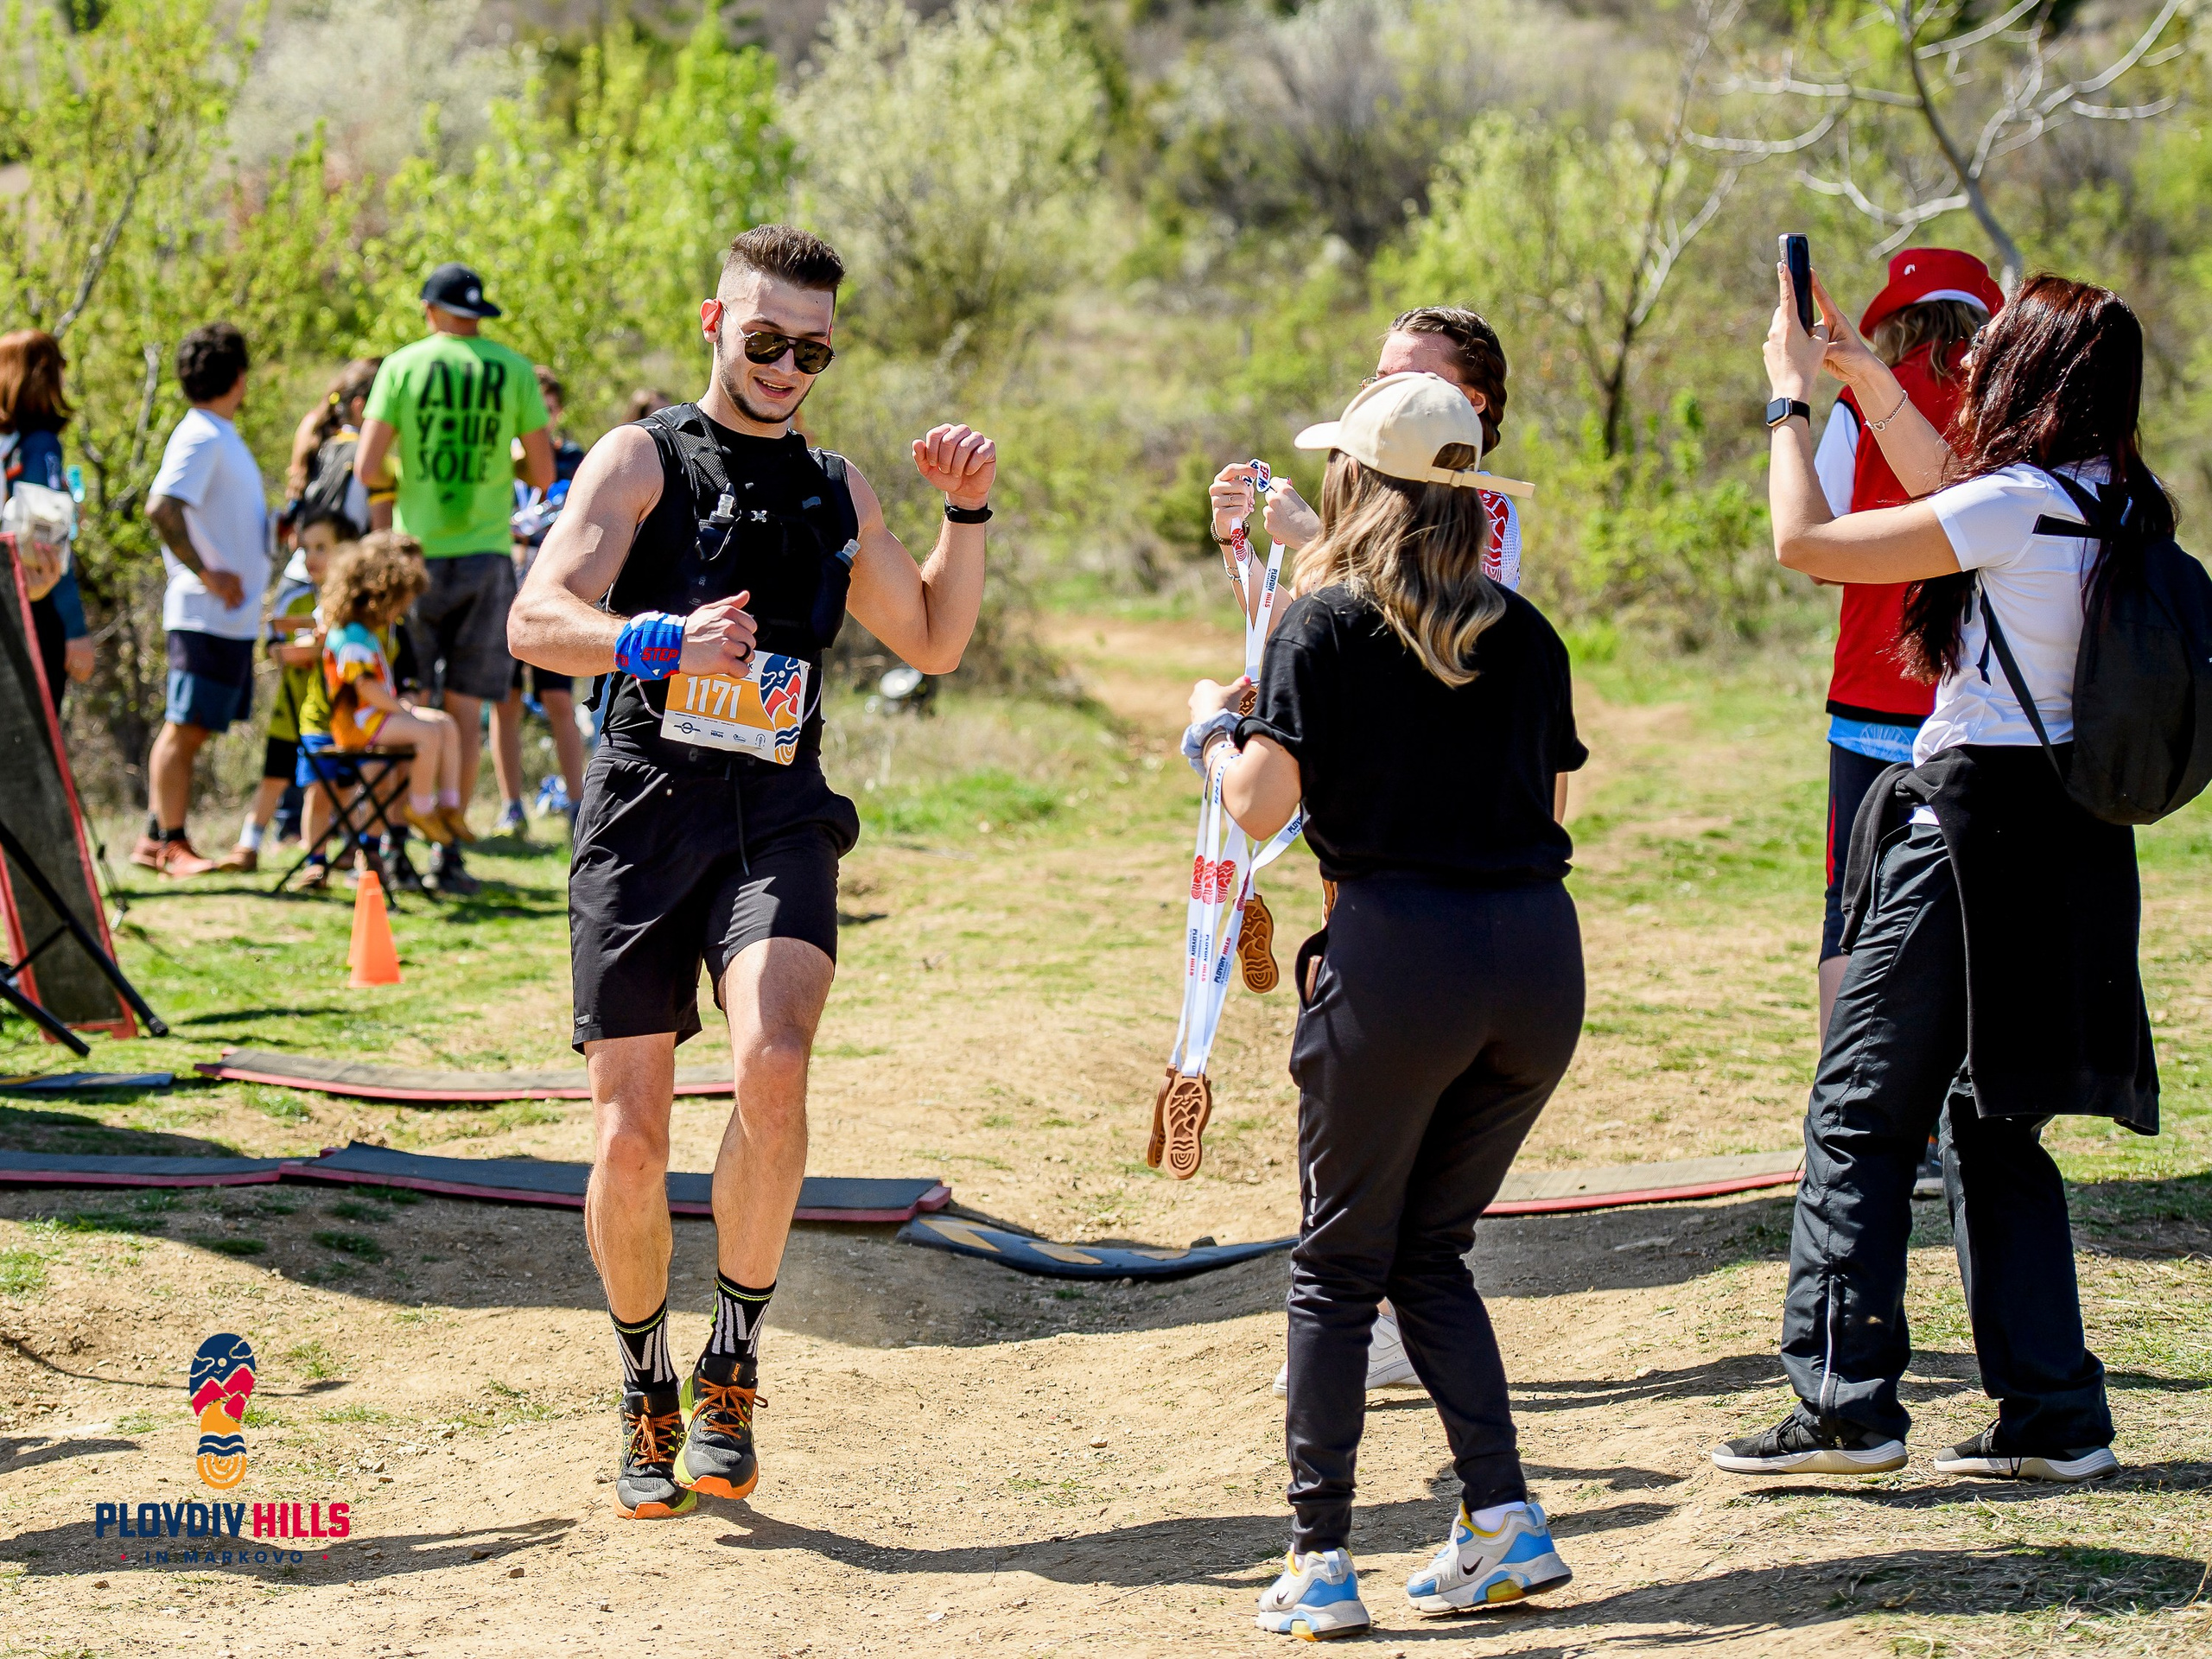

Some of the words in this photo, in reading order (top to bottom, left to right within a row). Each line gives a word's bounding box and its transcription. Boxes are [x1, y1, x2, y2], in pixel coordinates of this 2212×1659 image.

[418, 359, 506, 412] AIR
[641, 647, 679, 661] STEP
[685, 676, 742, 719] 1171
